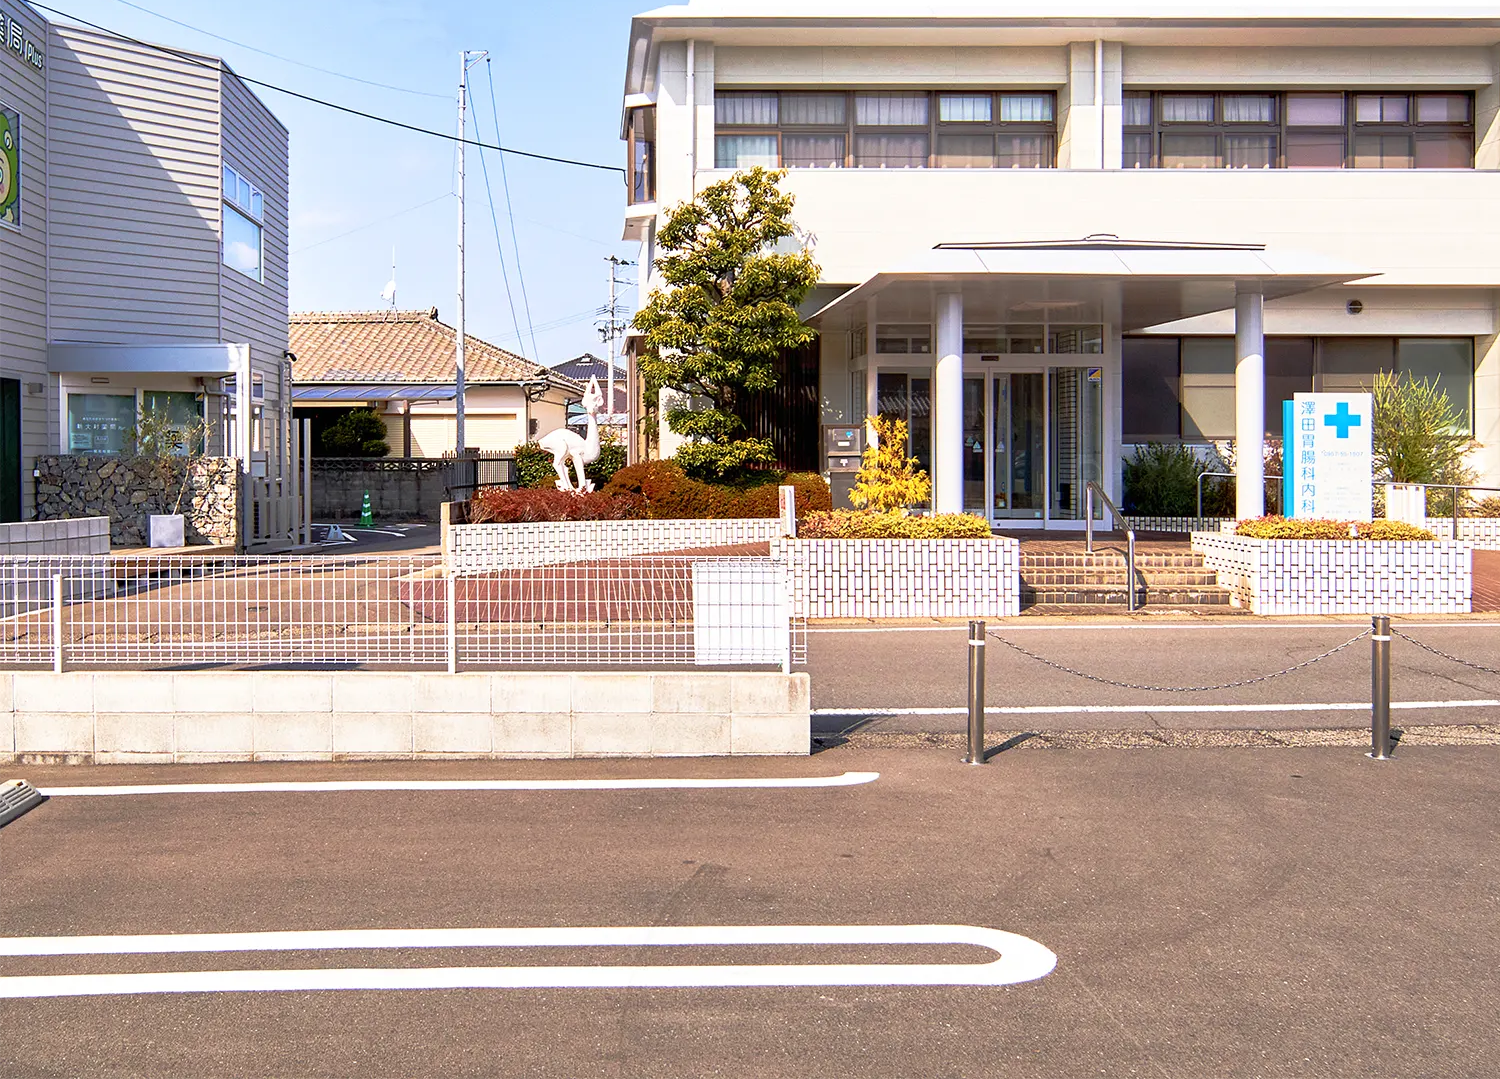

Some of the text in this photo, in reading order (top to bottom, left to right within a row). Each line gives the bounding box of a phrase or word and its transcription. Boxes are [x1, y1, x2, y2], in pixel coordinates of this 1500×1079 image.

[1301, 401, 1315, 513] 澤田胃腸科内科
